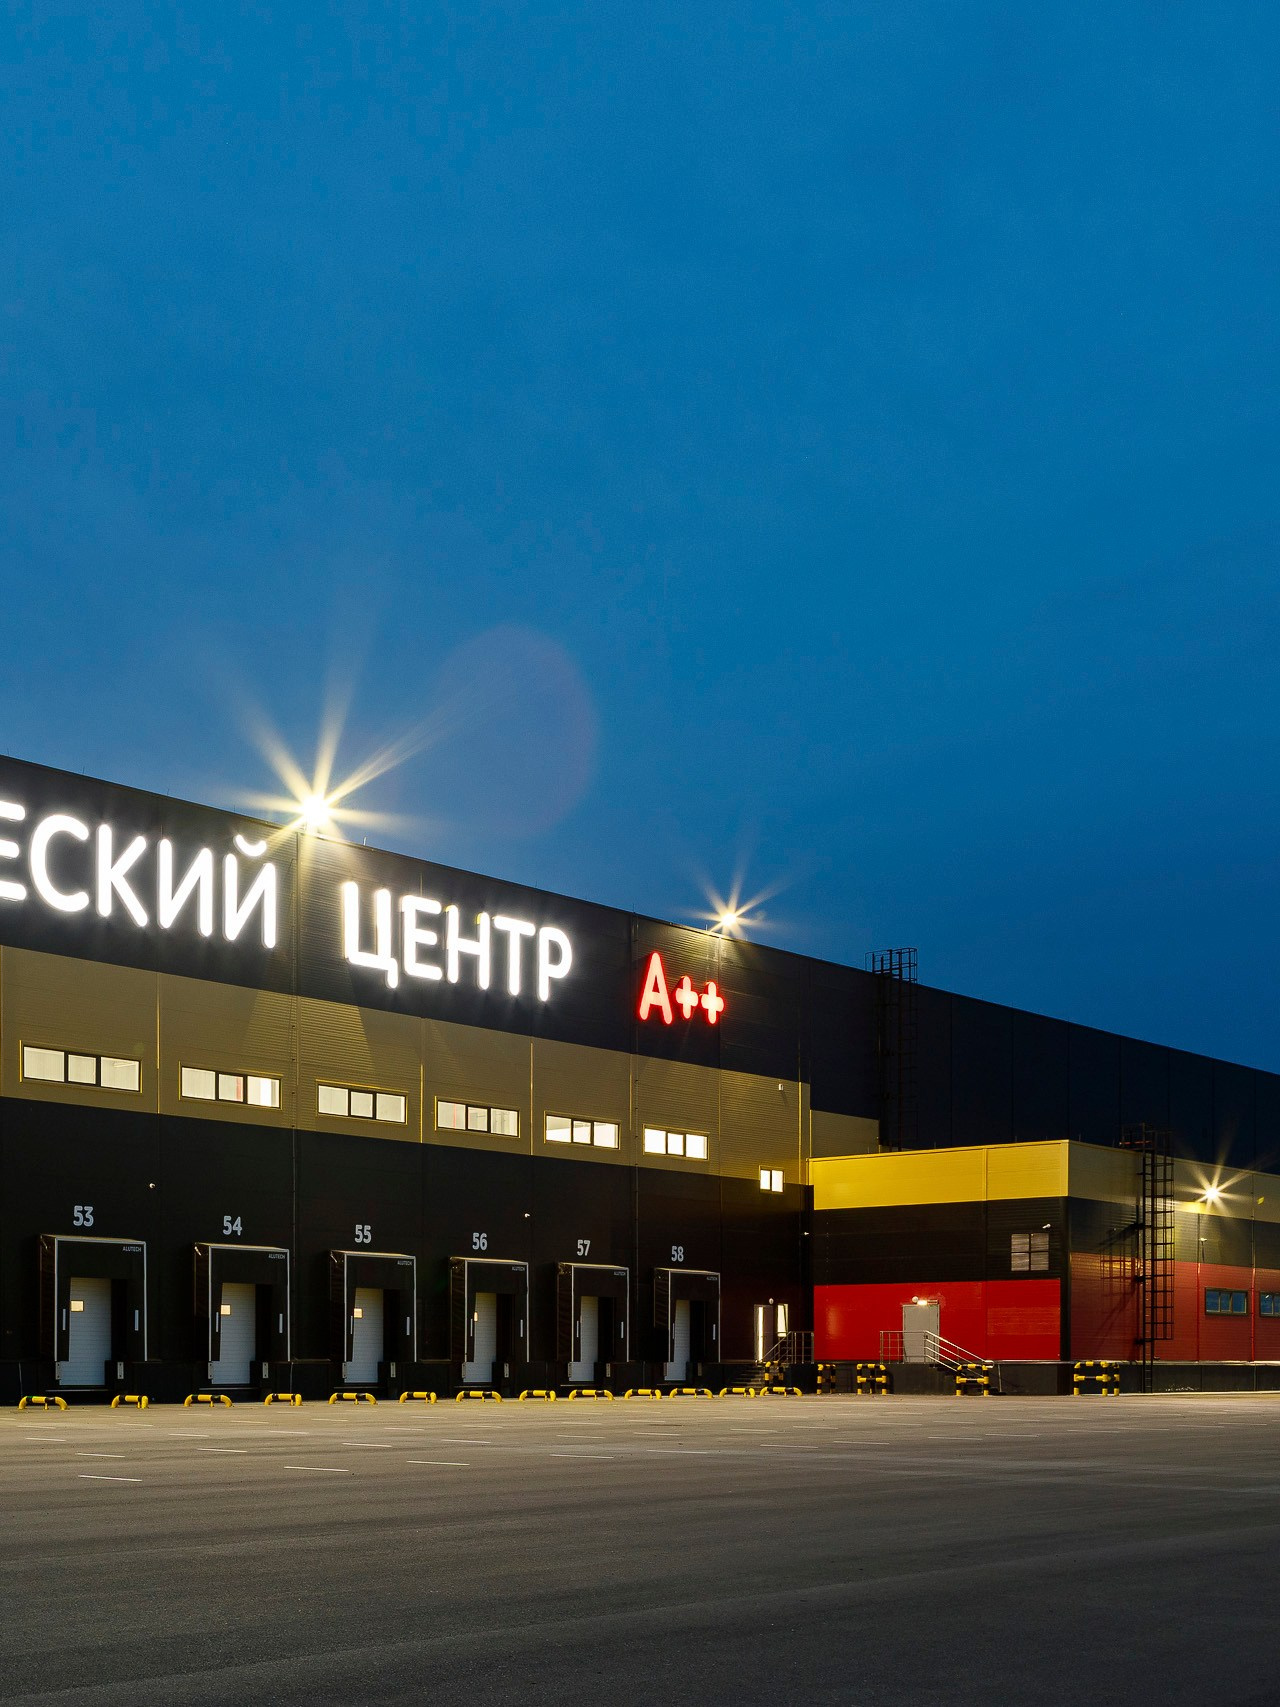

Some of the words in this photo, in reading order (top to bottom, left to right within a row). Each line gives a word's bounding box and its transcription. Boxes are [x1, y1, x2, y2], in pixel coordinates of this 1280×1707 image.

[342, 880, 573, 1002] ЦЕНТР
[72, 1205, 94, 1227] 53
[222, 1215, 243, 1236] 54
[354, 1224, 372, 1244] 55
[472, 1232, 488, 1251] 56
[576, 1239, 591, 1257] 57
[671, 1245, 684, 1262] 58
